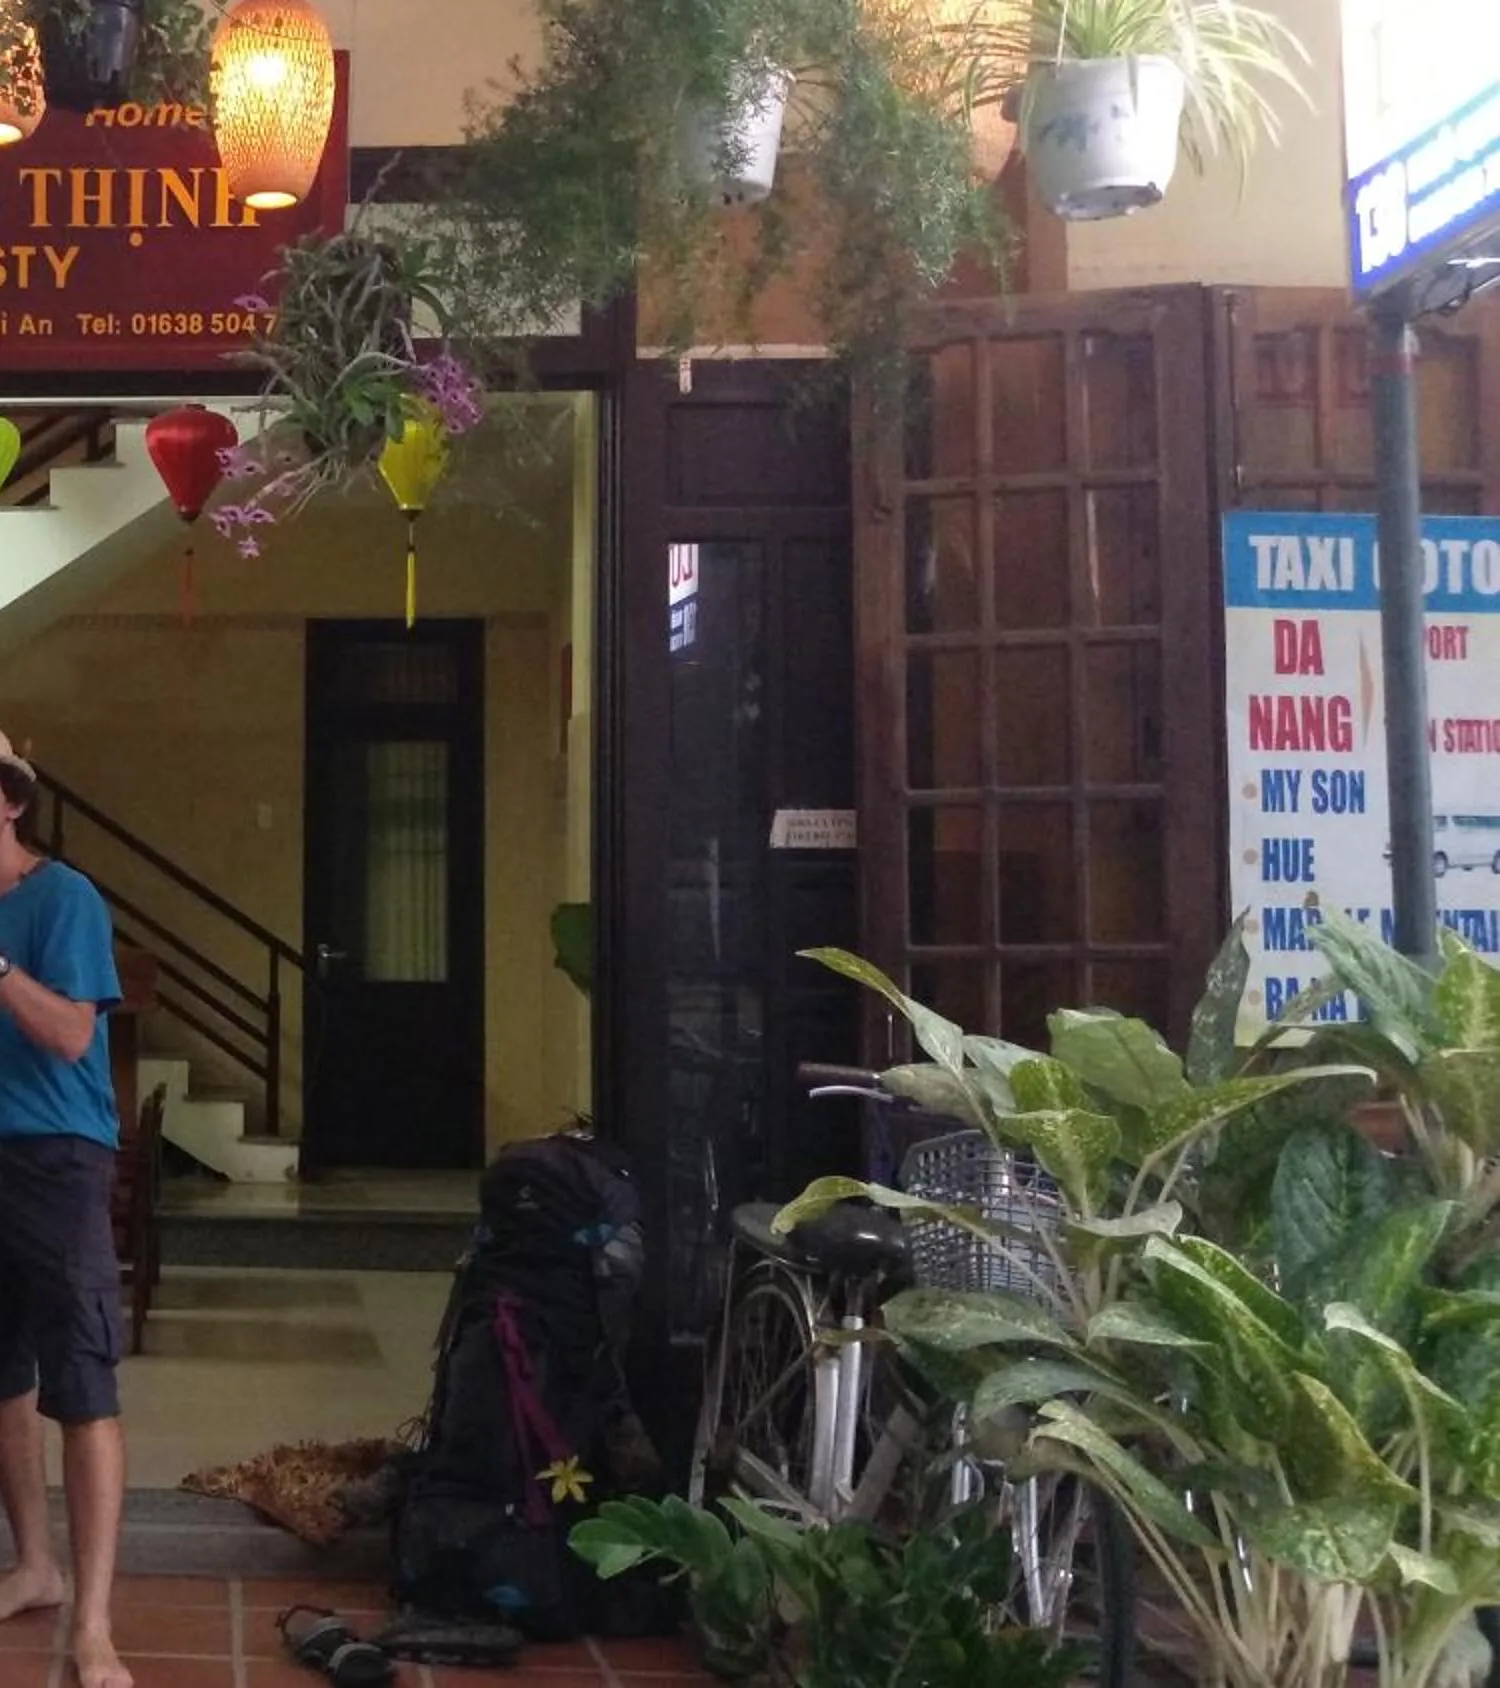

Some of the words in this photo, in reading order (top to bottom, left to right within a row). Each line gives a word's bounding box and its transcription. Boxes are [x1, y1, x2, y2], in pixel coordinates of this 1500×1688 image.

[19, 313, 53, 336] An
[77, 312, 121, 336] Tel:
[131, 312, 204, 336] 01638
[211, 312, 256, 336] 504
[1248, 535, 1354, 592] TAXI
[1273, 619, 1325, 677] DA
[1248, 694, 1354, 753] NANG
[1261, 769, 1301, 814] MY
[1311, 768, 1366, 815] SON
[1261, 838, 1316, 883] HUE
